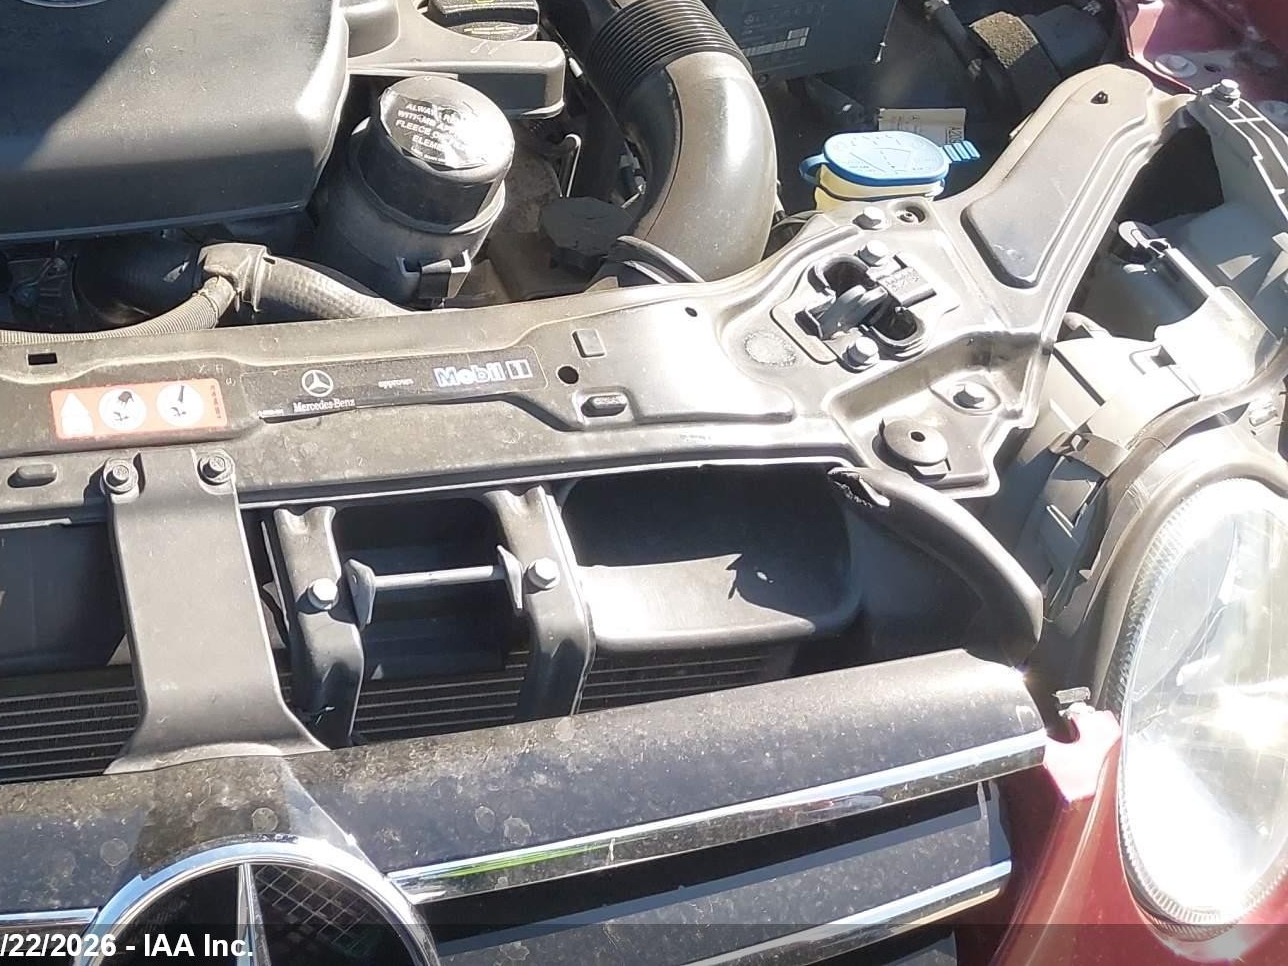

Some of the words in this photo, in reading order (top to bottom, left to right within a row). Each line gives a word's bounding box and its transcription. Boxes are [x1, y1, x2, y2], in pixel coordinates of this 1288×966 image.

[396, 119, 432, 136] FLEECE
[433, 362, 506, 387] Mobil
[509, 359, 530, 379] 1
[293, 398, 356, 413] Mercedes-Benz
